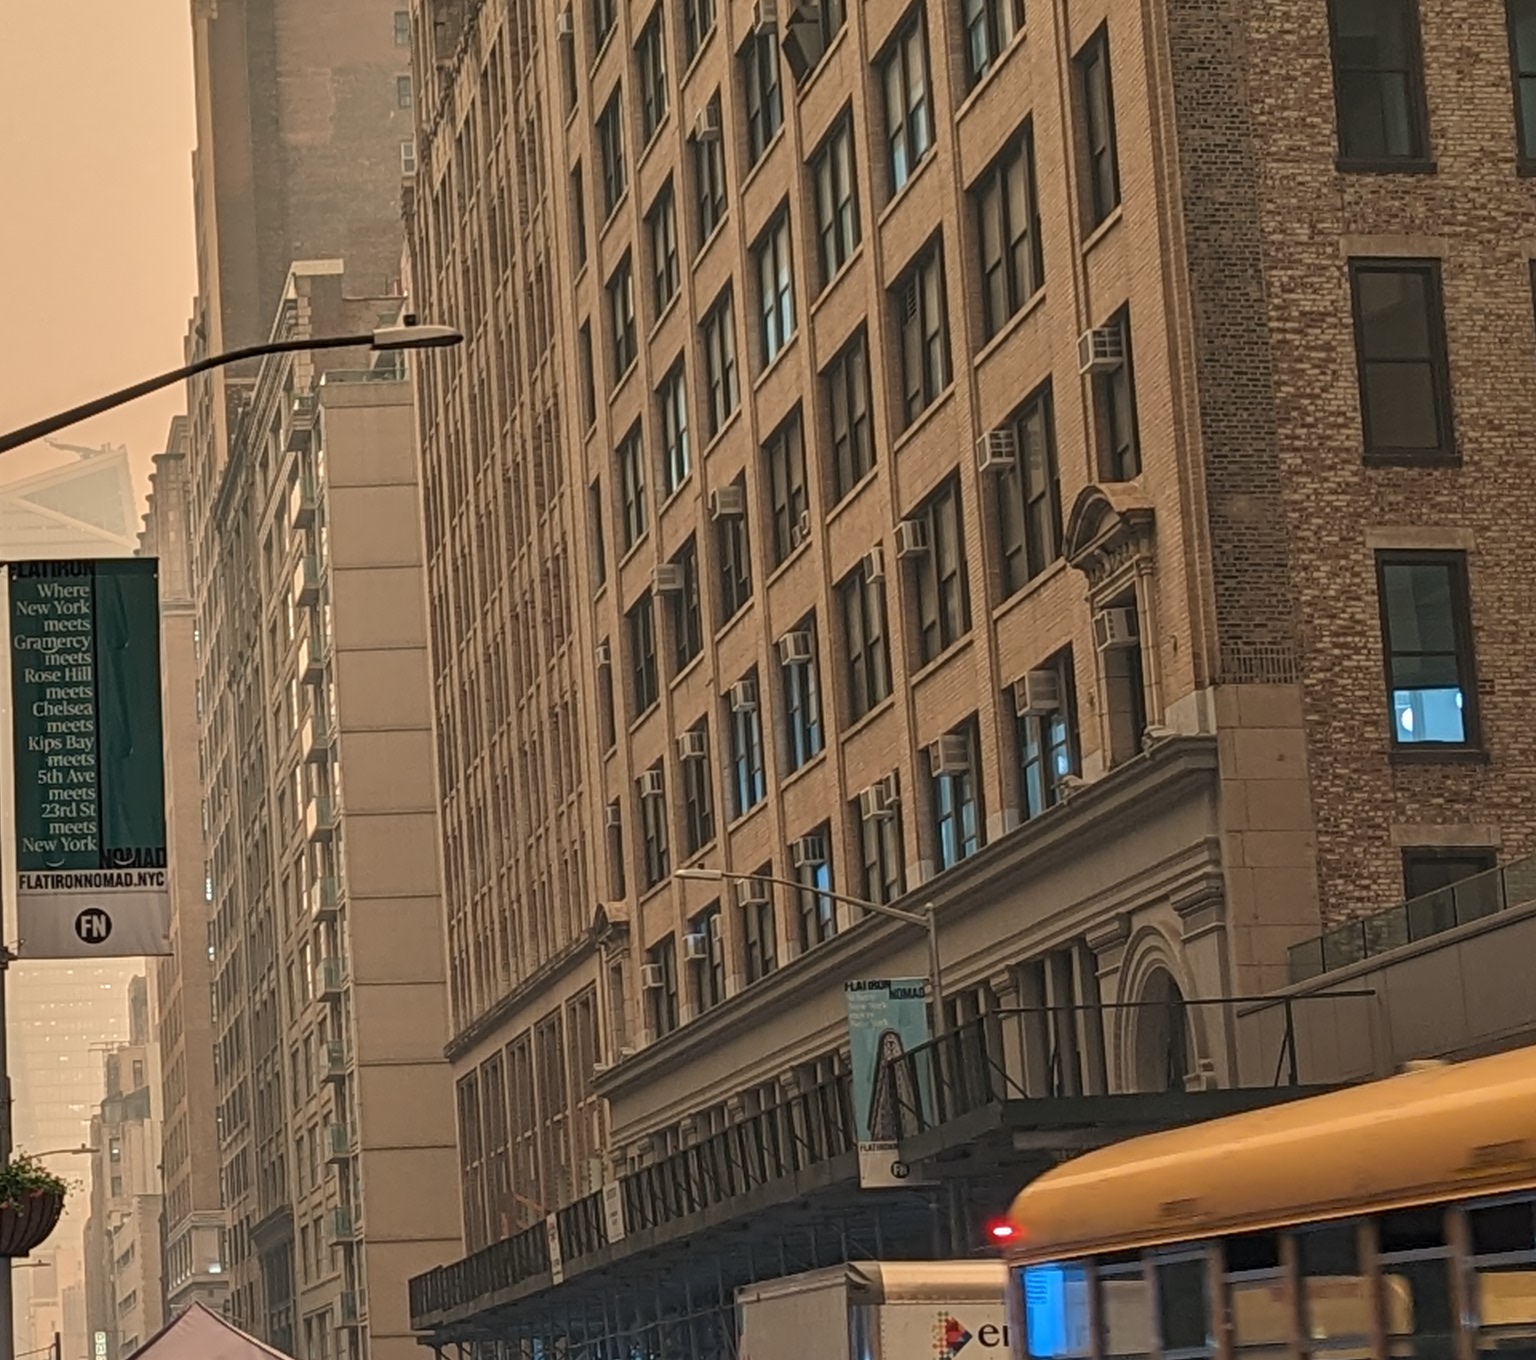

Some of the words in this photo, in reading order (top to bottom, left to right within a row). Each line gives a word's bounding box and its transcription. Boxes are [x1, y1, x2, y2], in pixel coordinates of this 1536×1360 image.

[37, 583, 90, 598] Where
[16, 601, 51, 616] New
[52, 599, 90, 615] York
[44, 619, 91, 632] meets
[14, 635, 92, 652] Gramercy
[45, 652, 92, 666] meets
[24, 668, 61, 683] Rose
[65, 667, 92, 682] Hill
[46, 686, 93, 700] meets
[33, 701, 93, 716] Chelsea
[47, 719, 94, 733] meets
[28, 736, 62, 753] Kips
[66, 735, 94, 752] Bay
[47, 753, 95, 767] meets
[38, 769, 63, 784] 5th
[67, 769, 95, 783] Ave
[49, 787, 96, 801] meets
[41, 802, 77, 818] 23rd
[80, 802, 96, 817] St
[49, 821, 97, 834] meets
[22, 838, 57, 853] New
[60, 835, 98, 852] York
[100, 847, 167, 868] NOMAD
[19, 871, 165, 890] FLATIRONNOMAD.NYC
[80, 914, 106, 938] FN
